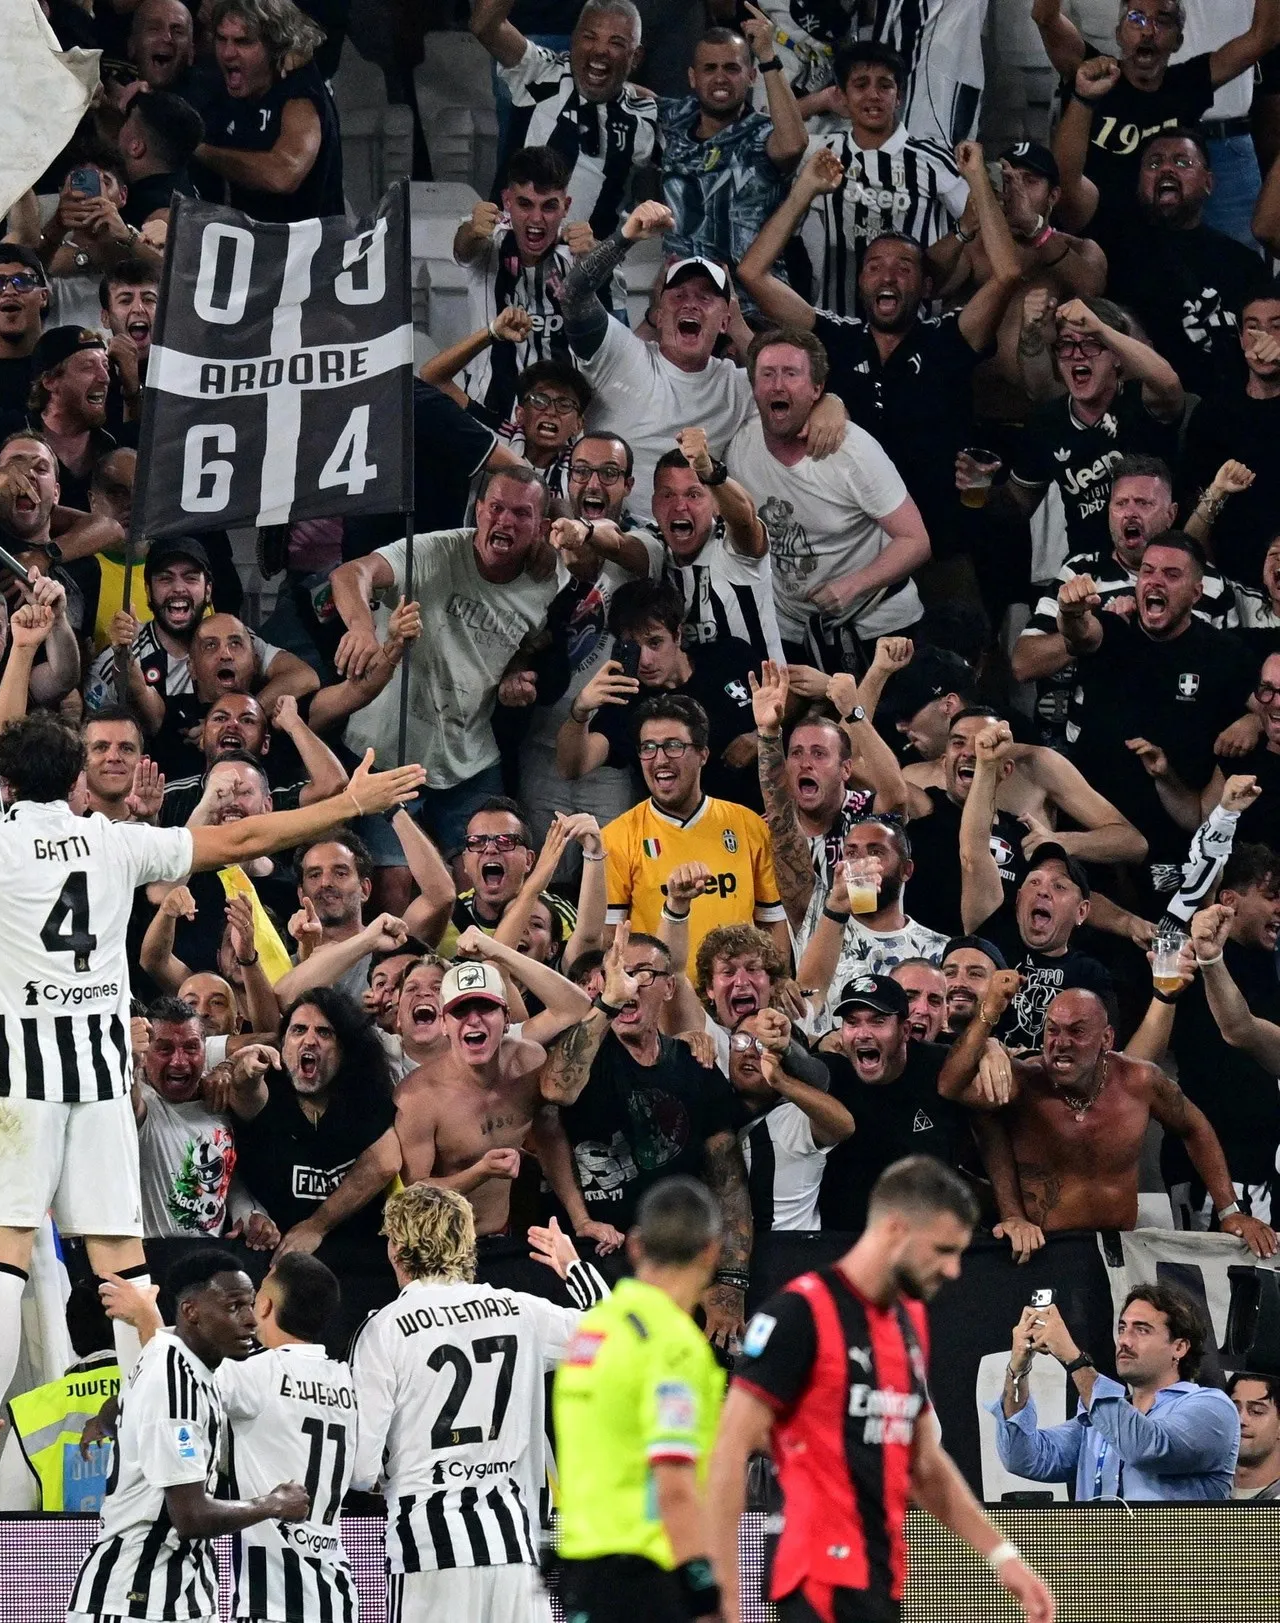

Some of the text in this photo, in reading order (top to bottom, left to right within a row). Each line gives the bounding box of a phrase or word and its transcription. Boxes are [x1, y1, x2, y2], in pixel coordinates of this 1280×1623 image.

[1091, 116, 1179, 155] 19
[529, 314, 564, 337] ep
[199, 347, 370, 394] ARDORE
[1083, 482, 1111, 501] VISIT
[1077, 499, 1107, 519] Detr
[683, 621, 717, 644] ep
[34, 835, 91, 863] GATTI
[40, 871, 98, 973] 4
[1037, 968, 1065, 986] PPO
[42, 982, 119, 1007] Cygames
[395, 1297, 521, 1338] WOLTEMADE
[66, 1378, 120, 1398] JUVEN
[426, 1334, 518, 1450] 27
[301, 1416, 347, 1527] 11
[448, 1460, 518, 1481] Cygam
[293, 1528, 338, 1553] Cygam
